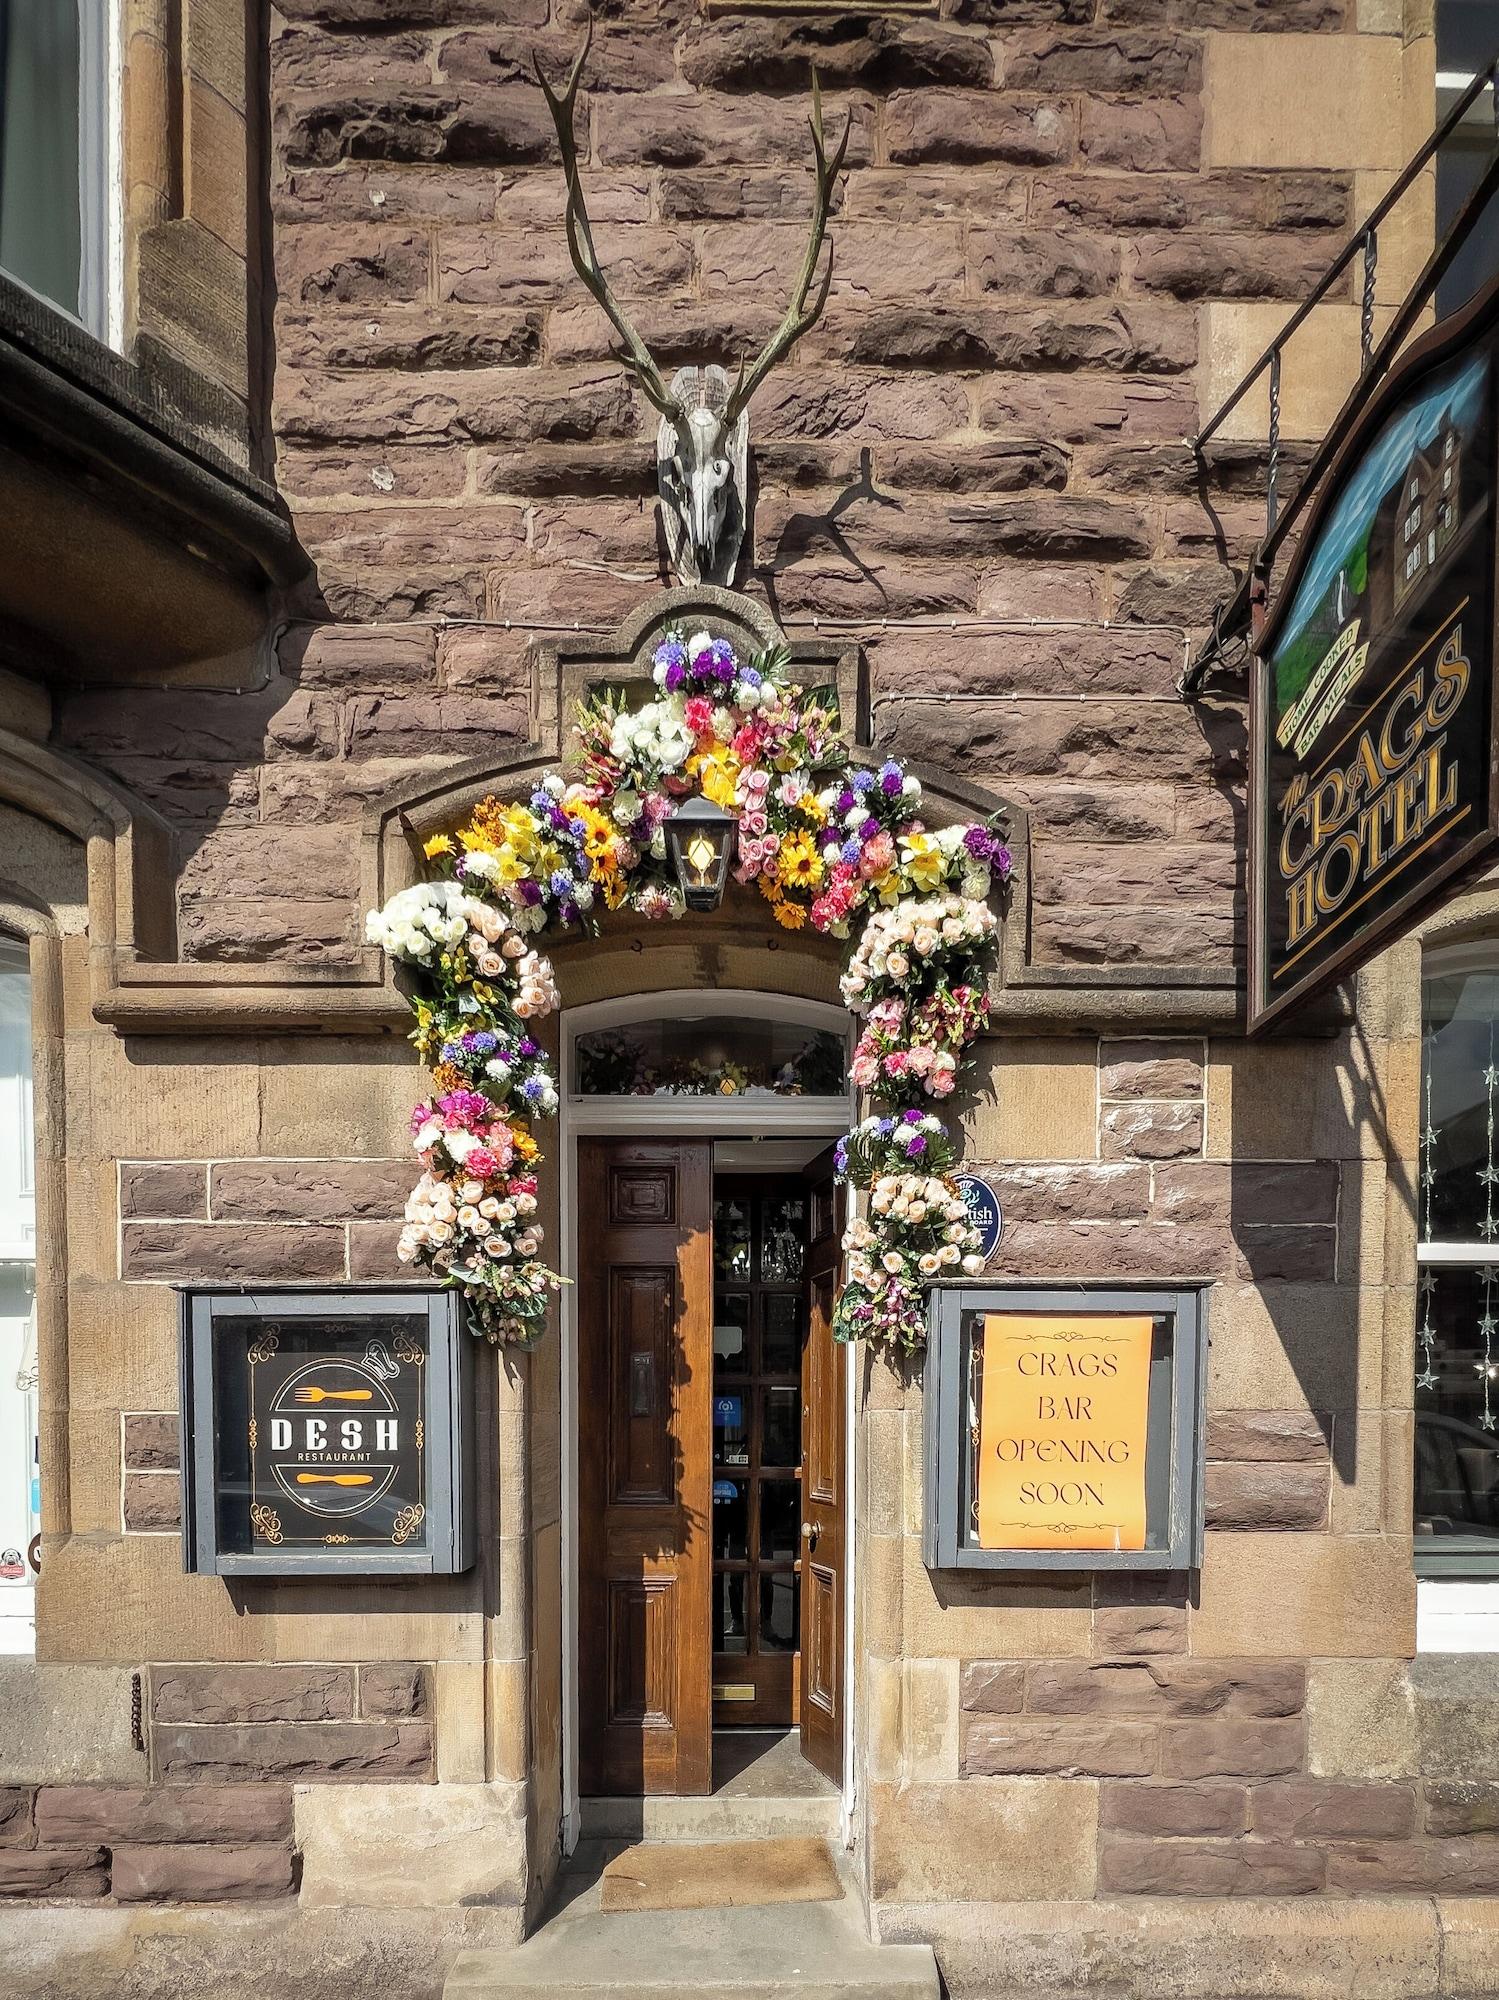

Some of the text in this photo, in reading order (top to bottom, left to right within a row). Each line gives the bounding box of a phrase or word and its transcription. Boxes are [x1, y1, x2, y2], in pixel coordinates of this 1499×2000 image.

[1285, 628, 1354, 740] HOME COOKED
[1301, 651, 1363, 753] BAR MEALS
[1279, 623, 1471, 880] CRAGS
[1285, 731, 1458, 951] HOTEL
[968, 1206, 993, 1220] tish
[1017, 1352, 1118, 1377] CRAGS
[1038, 1396, 1092, 1420] BAR
[271, 1418, 398, 1451] DESH
[297, 1452, 371, 1462] RESTAURANT
[996, 1438, 1129, 1464] OPENING
[1019, 1481, 1105, 1506] SOON
